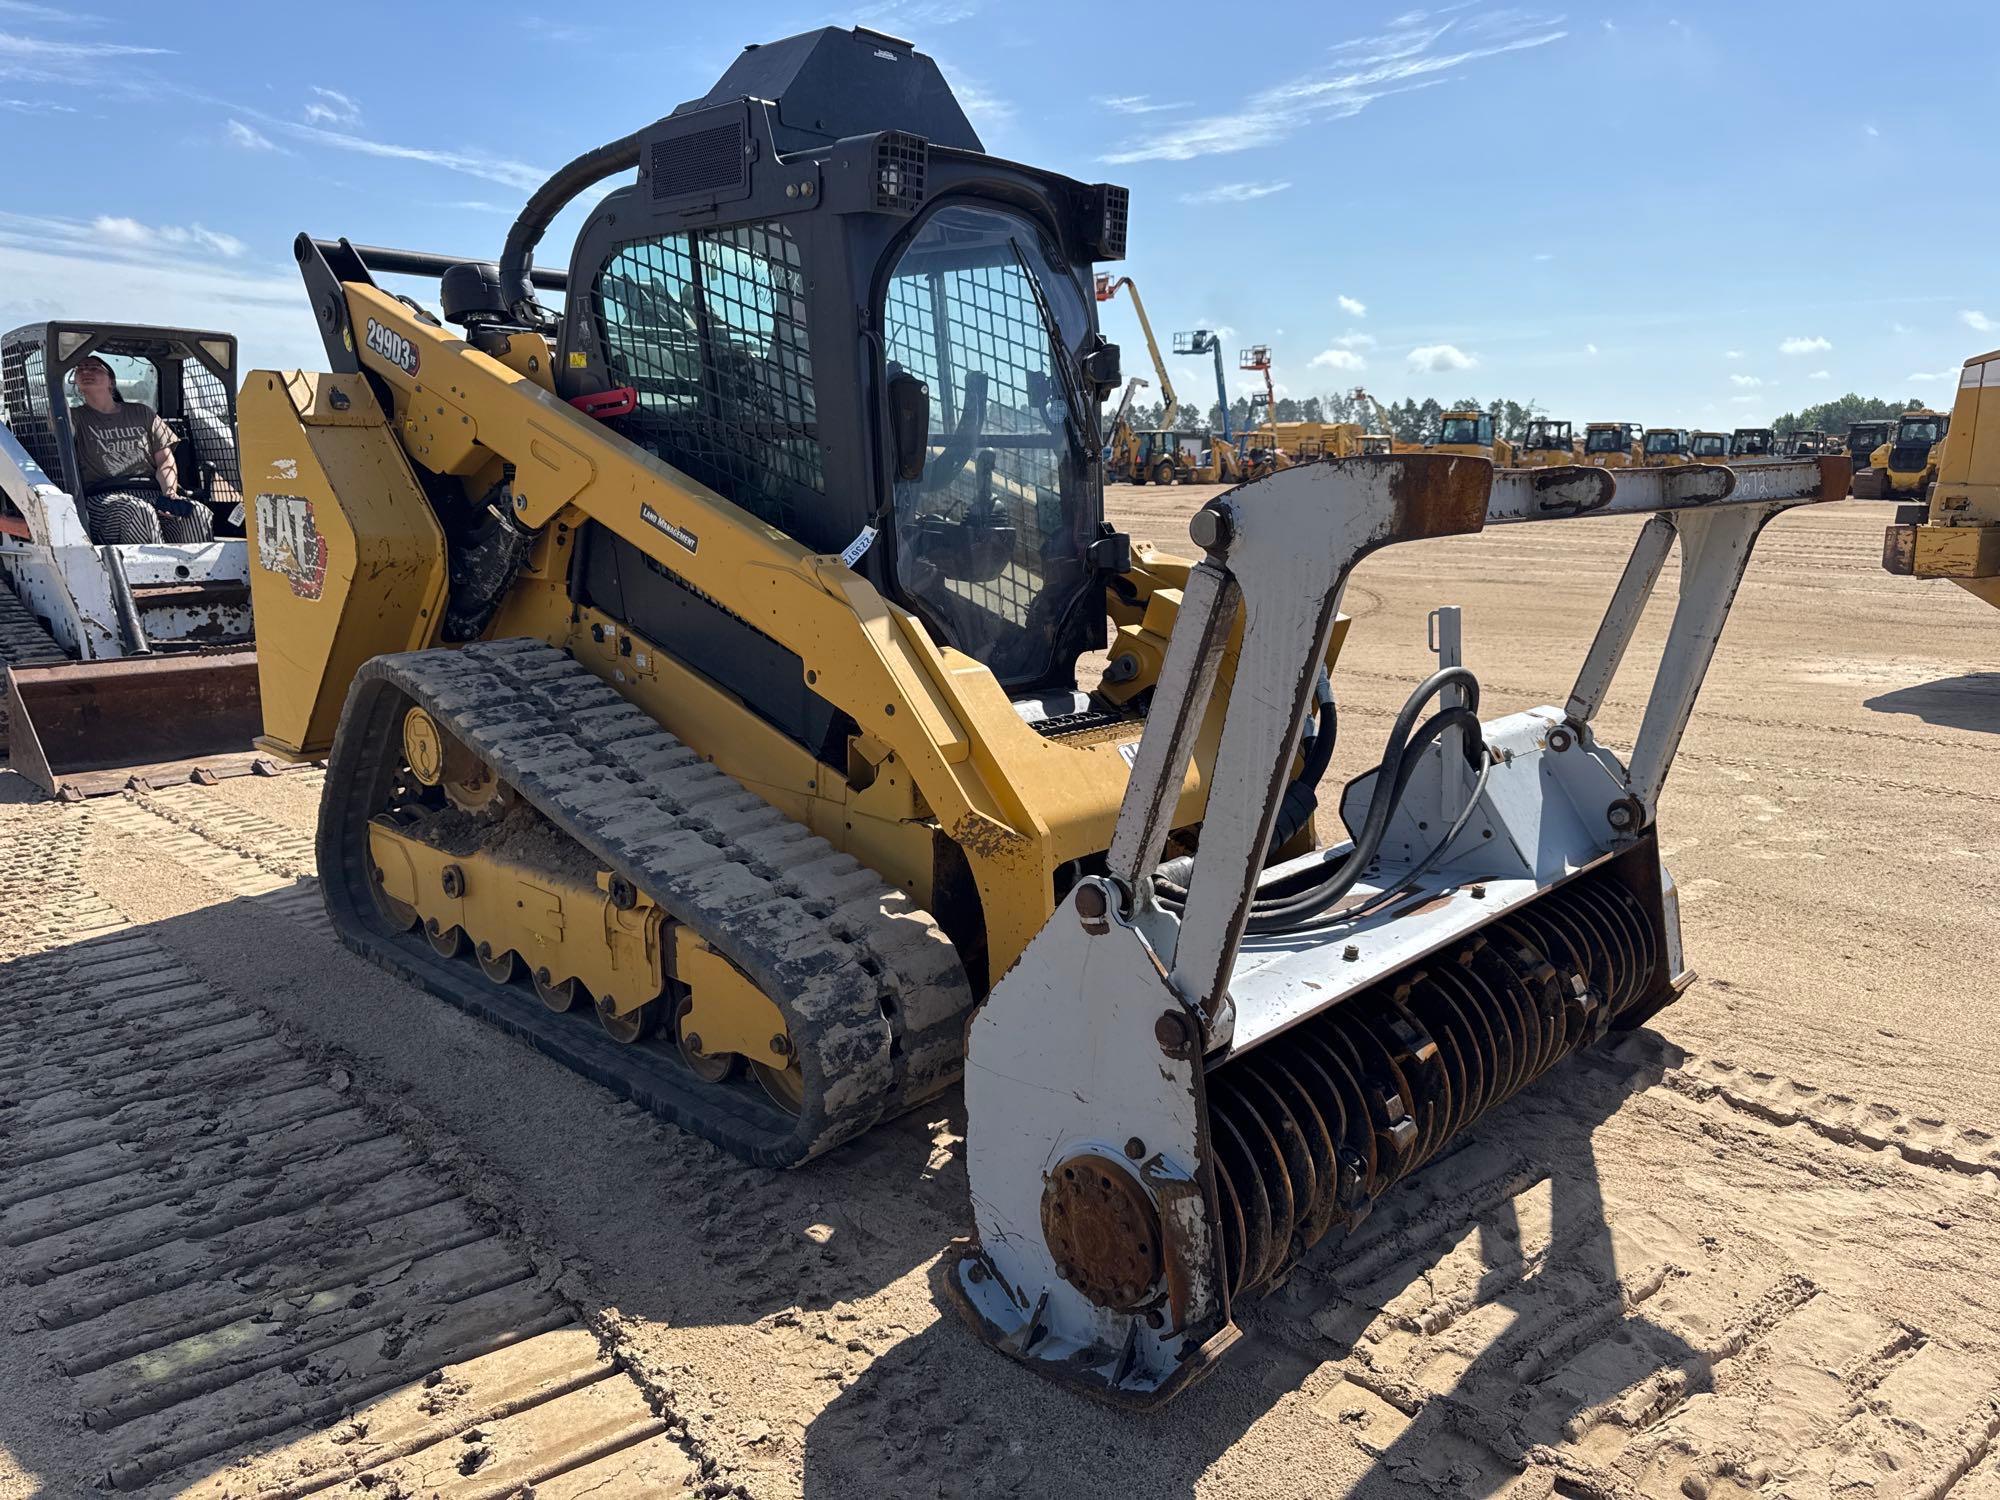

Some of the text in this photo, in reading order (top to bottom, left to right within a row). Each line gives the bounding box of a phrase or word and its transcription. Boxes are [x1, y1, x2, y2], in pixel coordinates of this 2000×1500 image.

[366, 317, 411, 370] 299D3
[88, 425, 146, 440] Nurture
[256, 495, 307, 573] CAT
[642, 507, 696, 548] LAND MANAGEMENT
[843, 537, 872, 566] 223672
